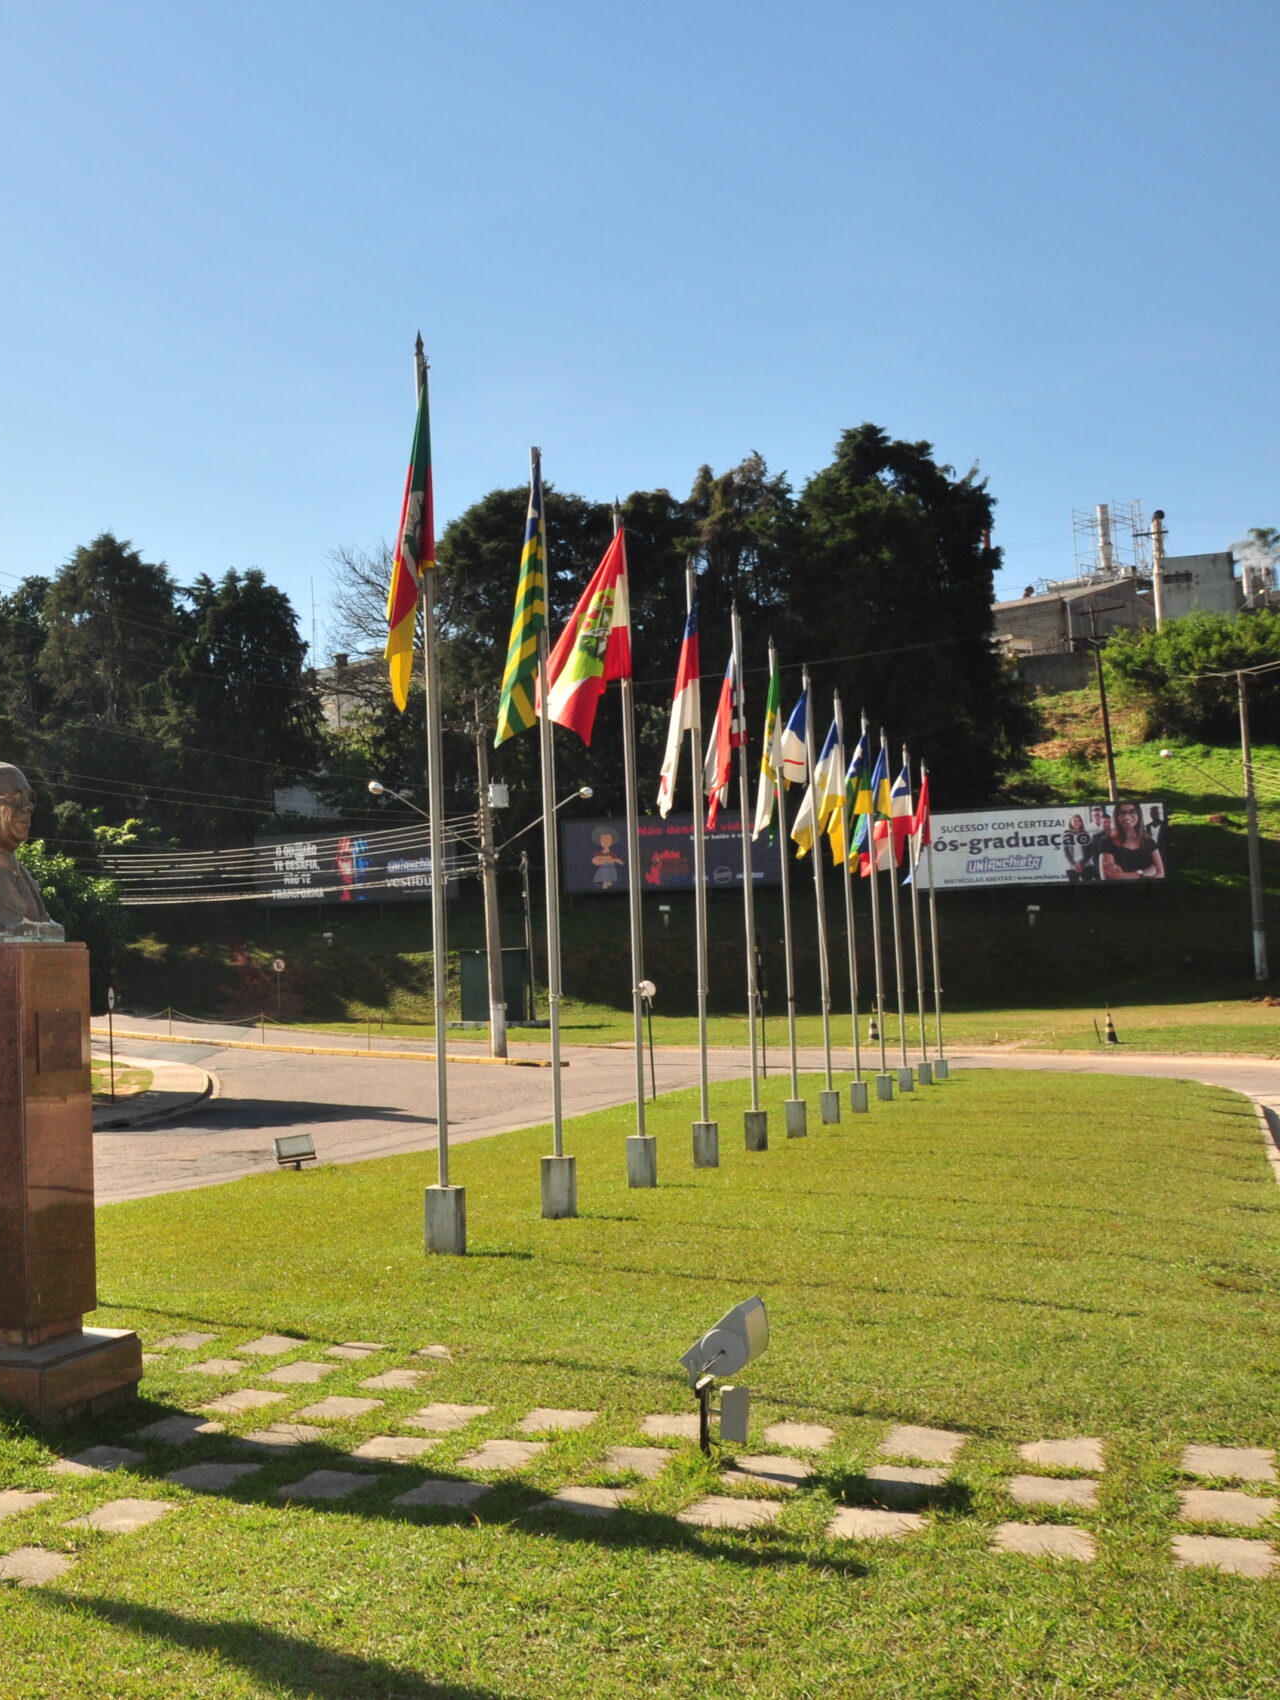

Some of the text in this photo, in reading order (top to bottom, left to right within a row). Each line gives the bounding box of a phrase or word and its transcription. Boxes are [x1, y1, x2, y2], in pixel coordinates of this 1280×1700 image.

[637, 825, 663, 836] Não
[941, 819, 1065, 834] SUCESSO? COM CERTEZA!
[921, 829, 1091, 855] ós-graduação
[273, 860, 284, 871] TE
[301, 873, 311, 884] TE
